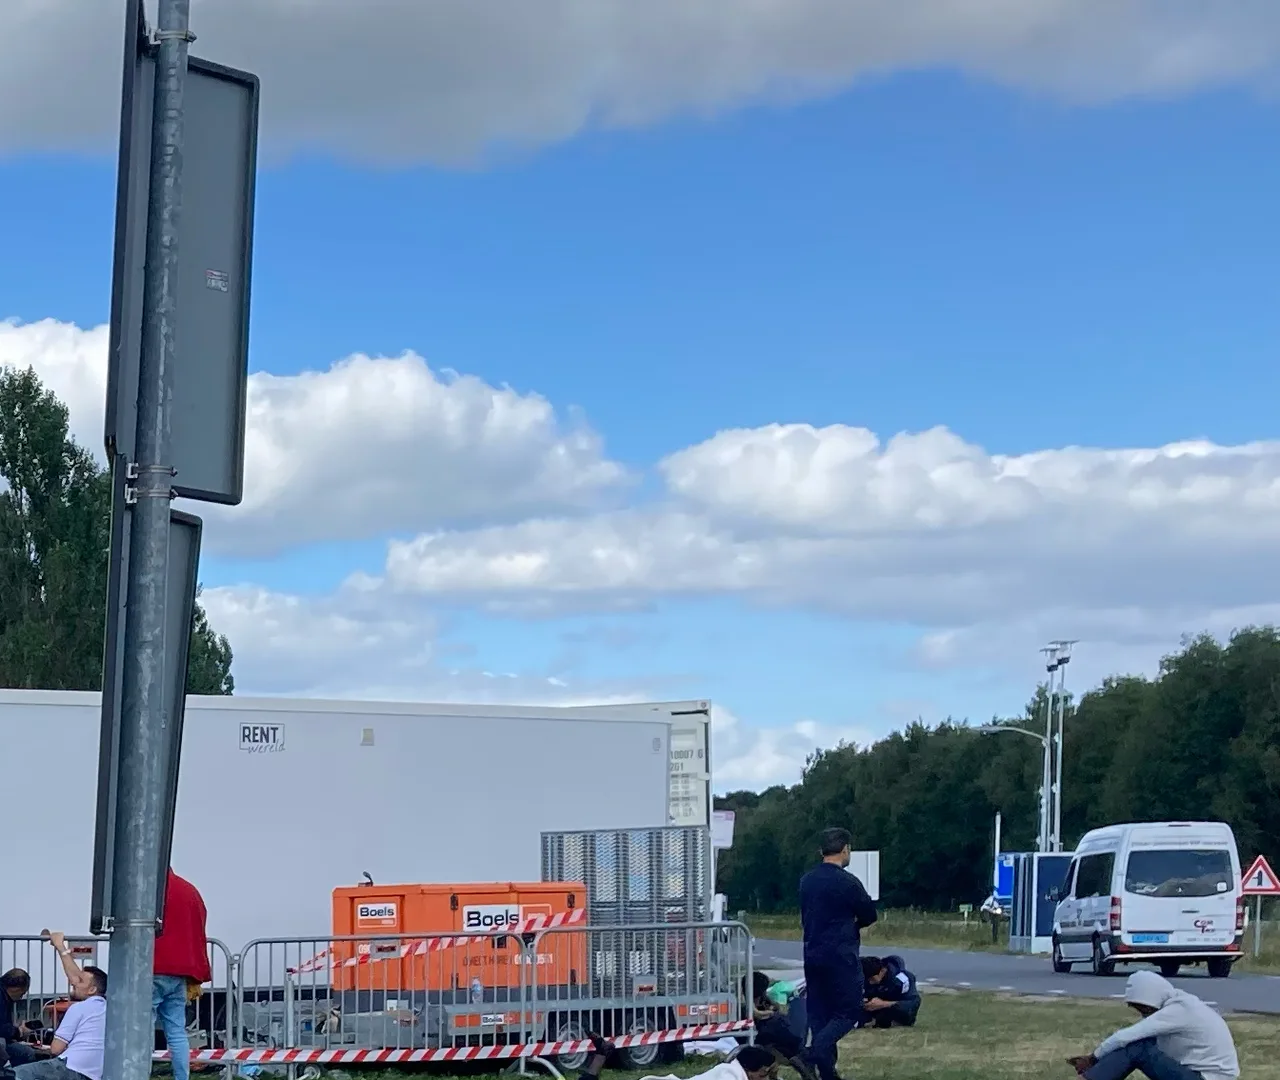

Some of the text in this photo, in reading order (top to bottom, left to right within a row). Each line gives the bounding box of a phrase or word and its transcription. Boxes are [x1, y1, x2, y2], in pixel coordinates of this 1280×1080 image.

[242, 726, 279, 743] RENT
[359, 906, 395, 917] Boels
[466, 909, 520, 928] Boels
